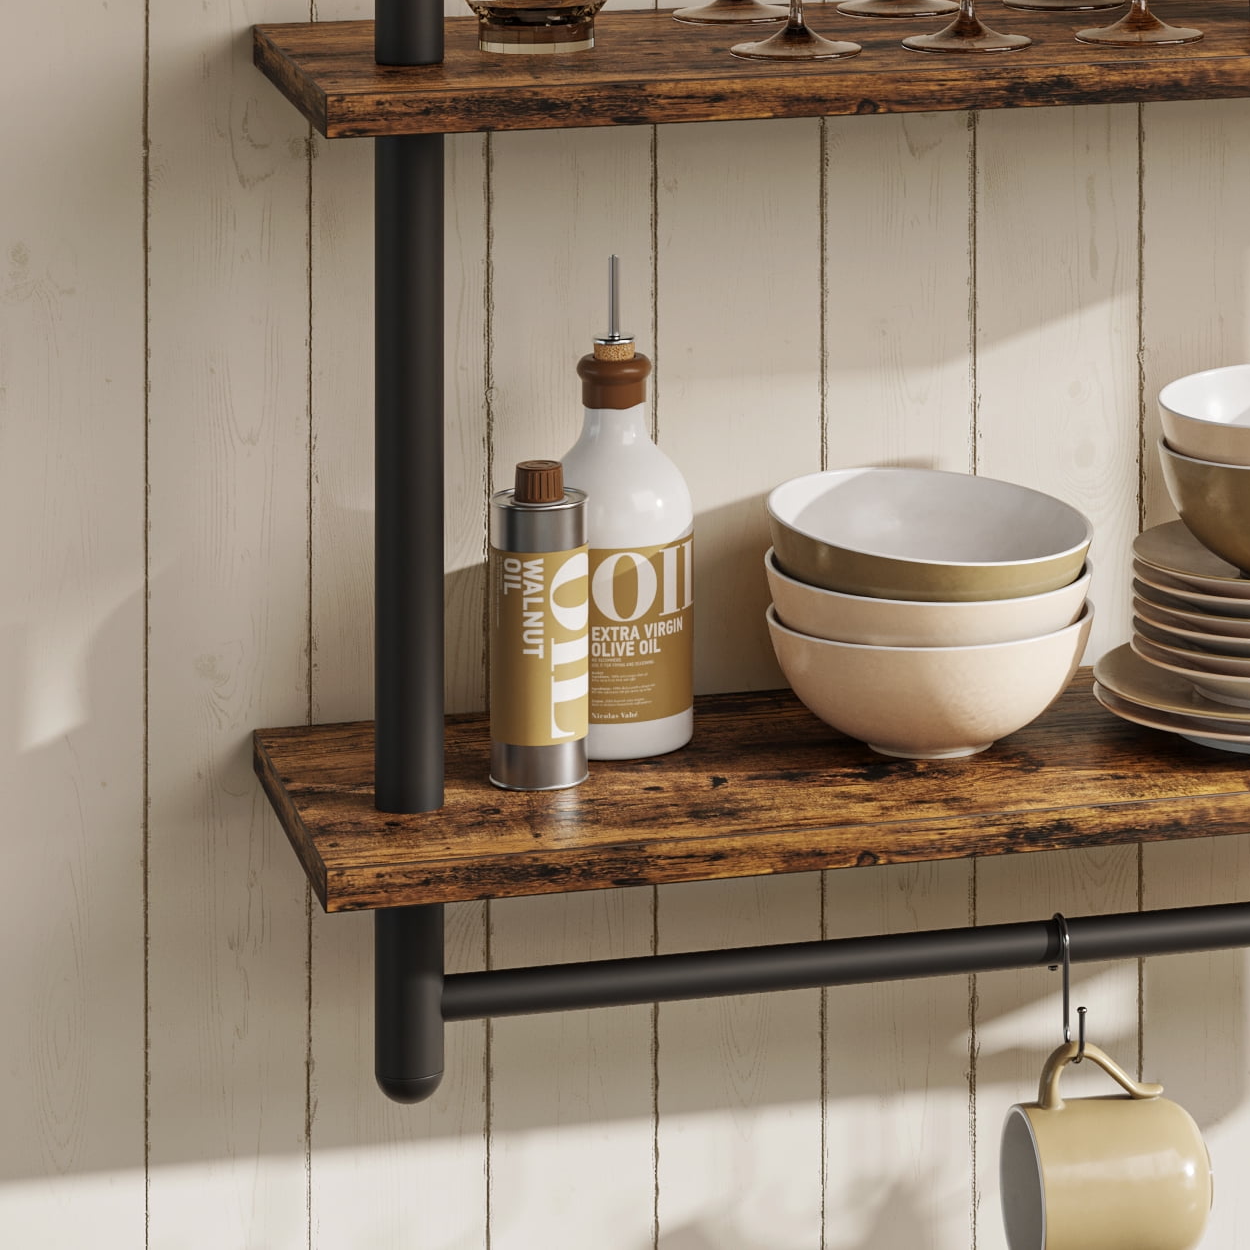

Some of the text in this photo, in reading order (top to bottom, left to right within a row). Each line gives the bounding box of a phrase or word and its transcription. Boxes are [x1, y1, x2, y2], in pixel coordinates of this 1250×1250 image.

[503, 558, 522, 595] OIL
[523, 558, 544, 659] WALNUT
[592, 616, 683, 642] EXTRA VIRGIN
[592, 638, 662, 657] OLIVE OIL
